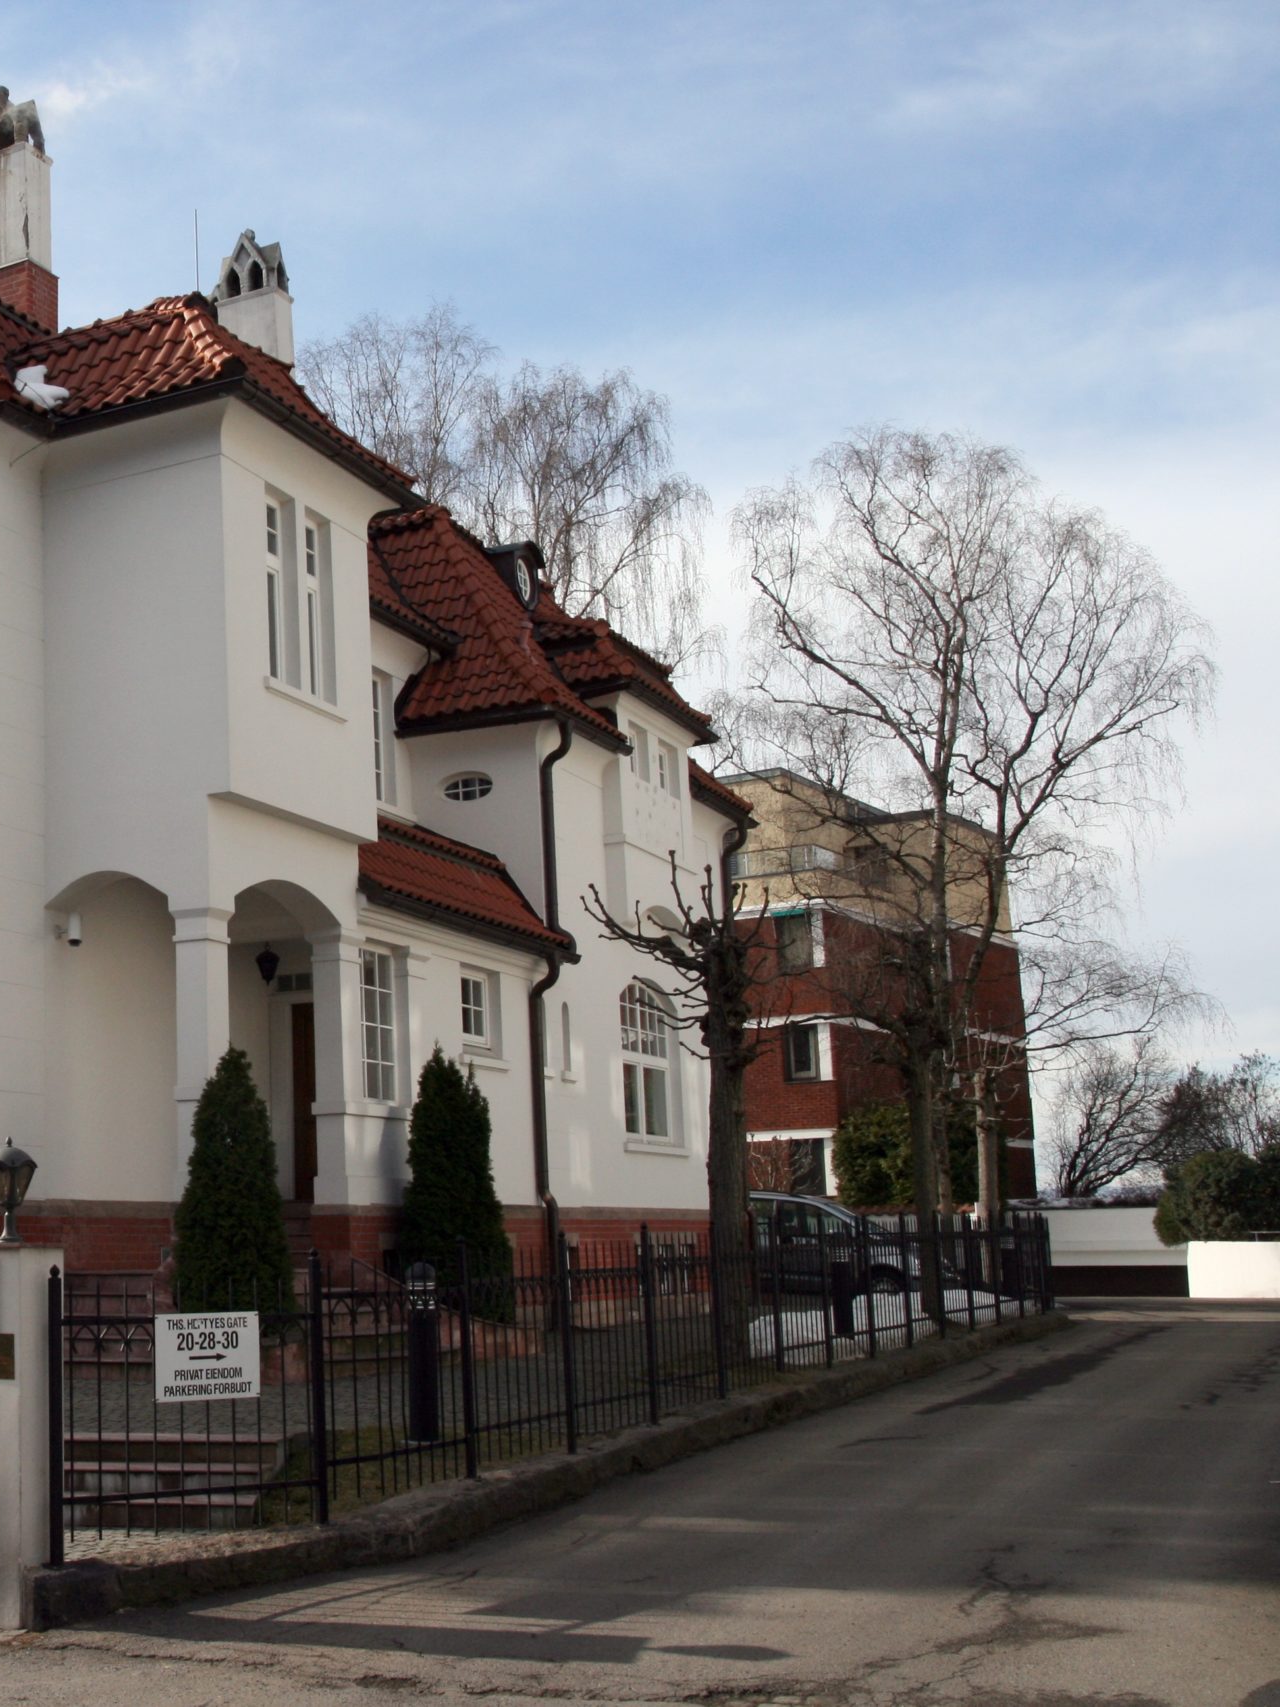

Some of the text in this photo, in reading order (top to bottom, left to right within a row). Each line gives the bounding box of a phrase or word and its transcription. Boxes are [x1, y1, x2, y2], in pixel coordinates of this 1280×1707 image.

[167, 1319, 186, 1330] THS.
[227, 1317, 247, 1328] GATE
[176, 1330, 239, 1351] 20-28-30
[174, 1367, 242, 1381] PRIVAT EIENDOM
[164, 1382, 252, 1396] PARKERING FORBUDT
